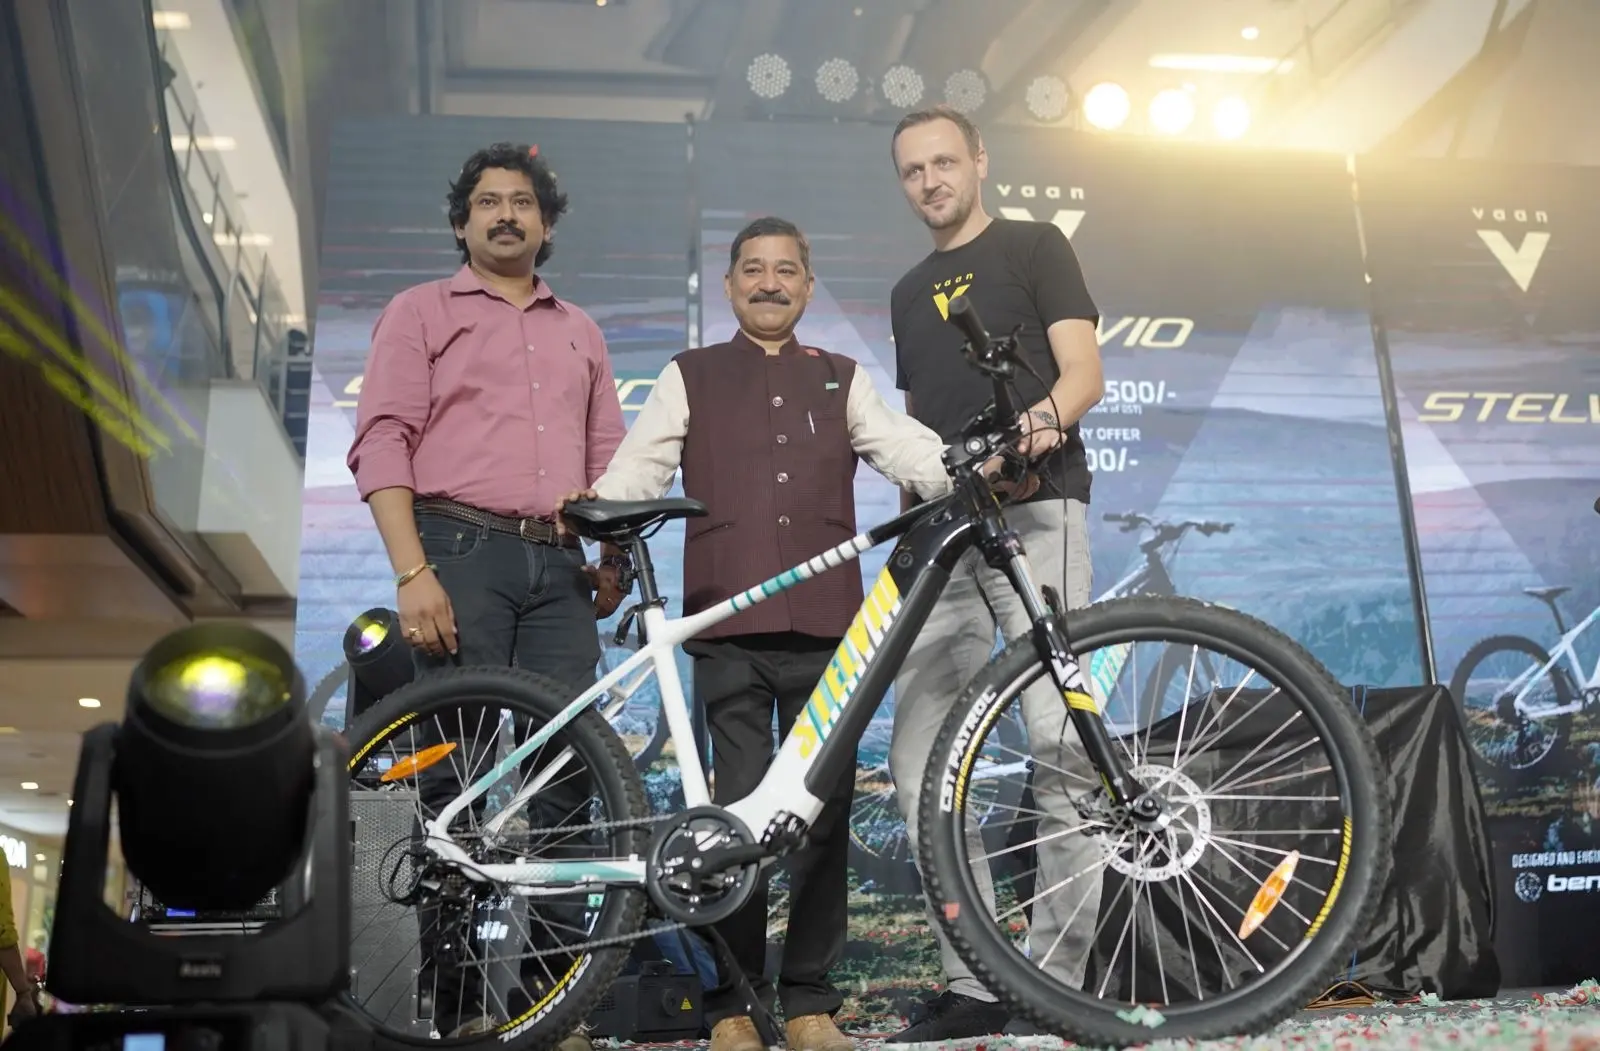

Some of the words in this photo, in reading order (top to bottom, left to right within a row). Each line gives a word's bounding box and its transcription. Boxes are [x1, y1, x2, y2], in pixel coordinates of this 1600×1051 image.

[996, 183, 1085, 200] vaan
[1471, 206, 1549, 223] vaan
[934, 272, 973, 291] vaan
[1096, 427, 1141, 441] OFFER
[1511, 853, 1556, 868] DESIGNED
[1556, 850, 1576, 866] AND
